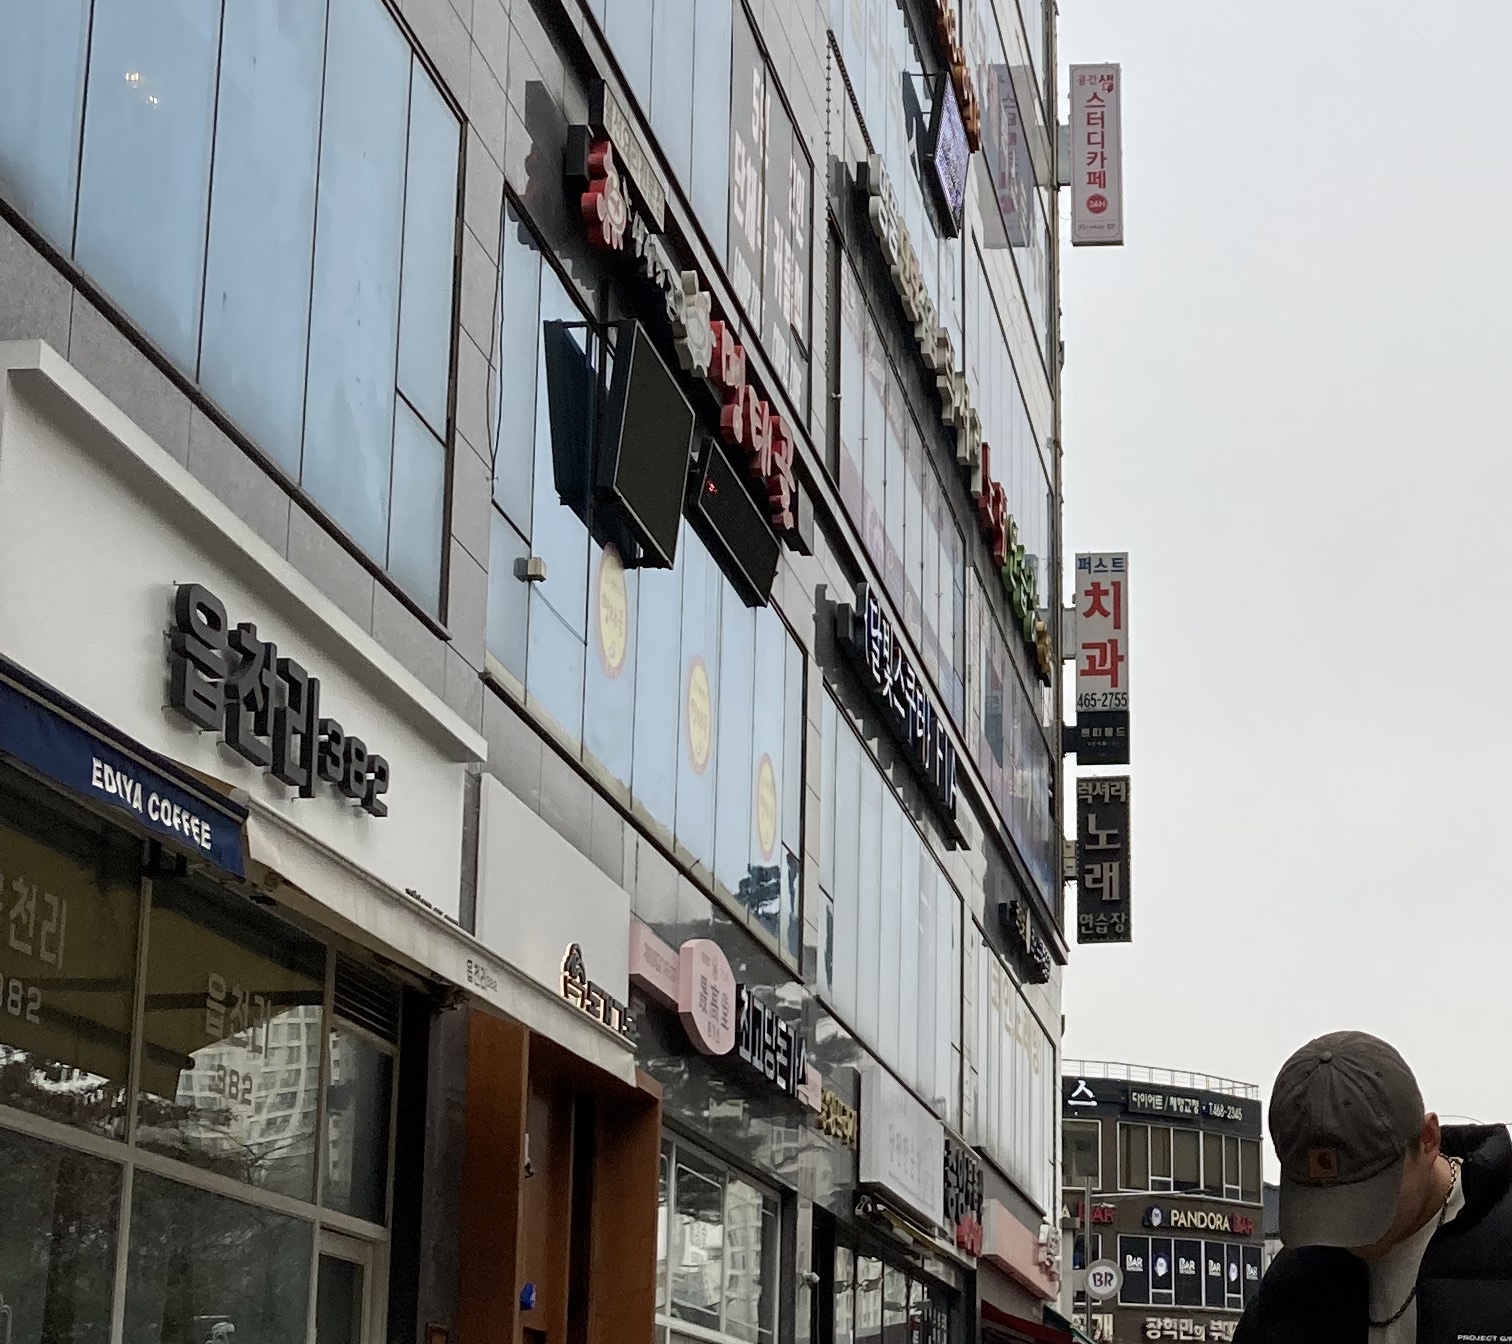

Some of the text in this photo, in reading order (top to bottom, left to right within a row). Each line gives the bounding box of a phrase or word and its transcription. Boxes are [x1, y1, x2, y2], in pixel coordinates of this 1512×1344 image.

[1084, 91, 1107, 189] 스터디카페
[1078, 556, 1126, 575] 퍼스트
[1079, 581, 1125, 688] 치과
[1077, 692, 1128, 708] 465-2755
[91, 756, 213, 851] EDIYA COFFEE
[1077, 781, 1128, 805] 럭셔리
[1084, 812, 1122, 901] 노래
[0, 869, 67, 973] 천리
[1079, 913, 1127, 935] 연습장
[0, 969, 43, 1025] 82
[1170, 1208, 1231, 1232] PANDORA
[1092, 1271, 1115, 1288] BR
[1457, 1334, 1498, 1342] PROJECT
